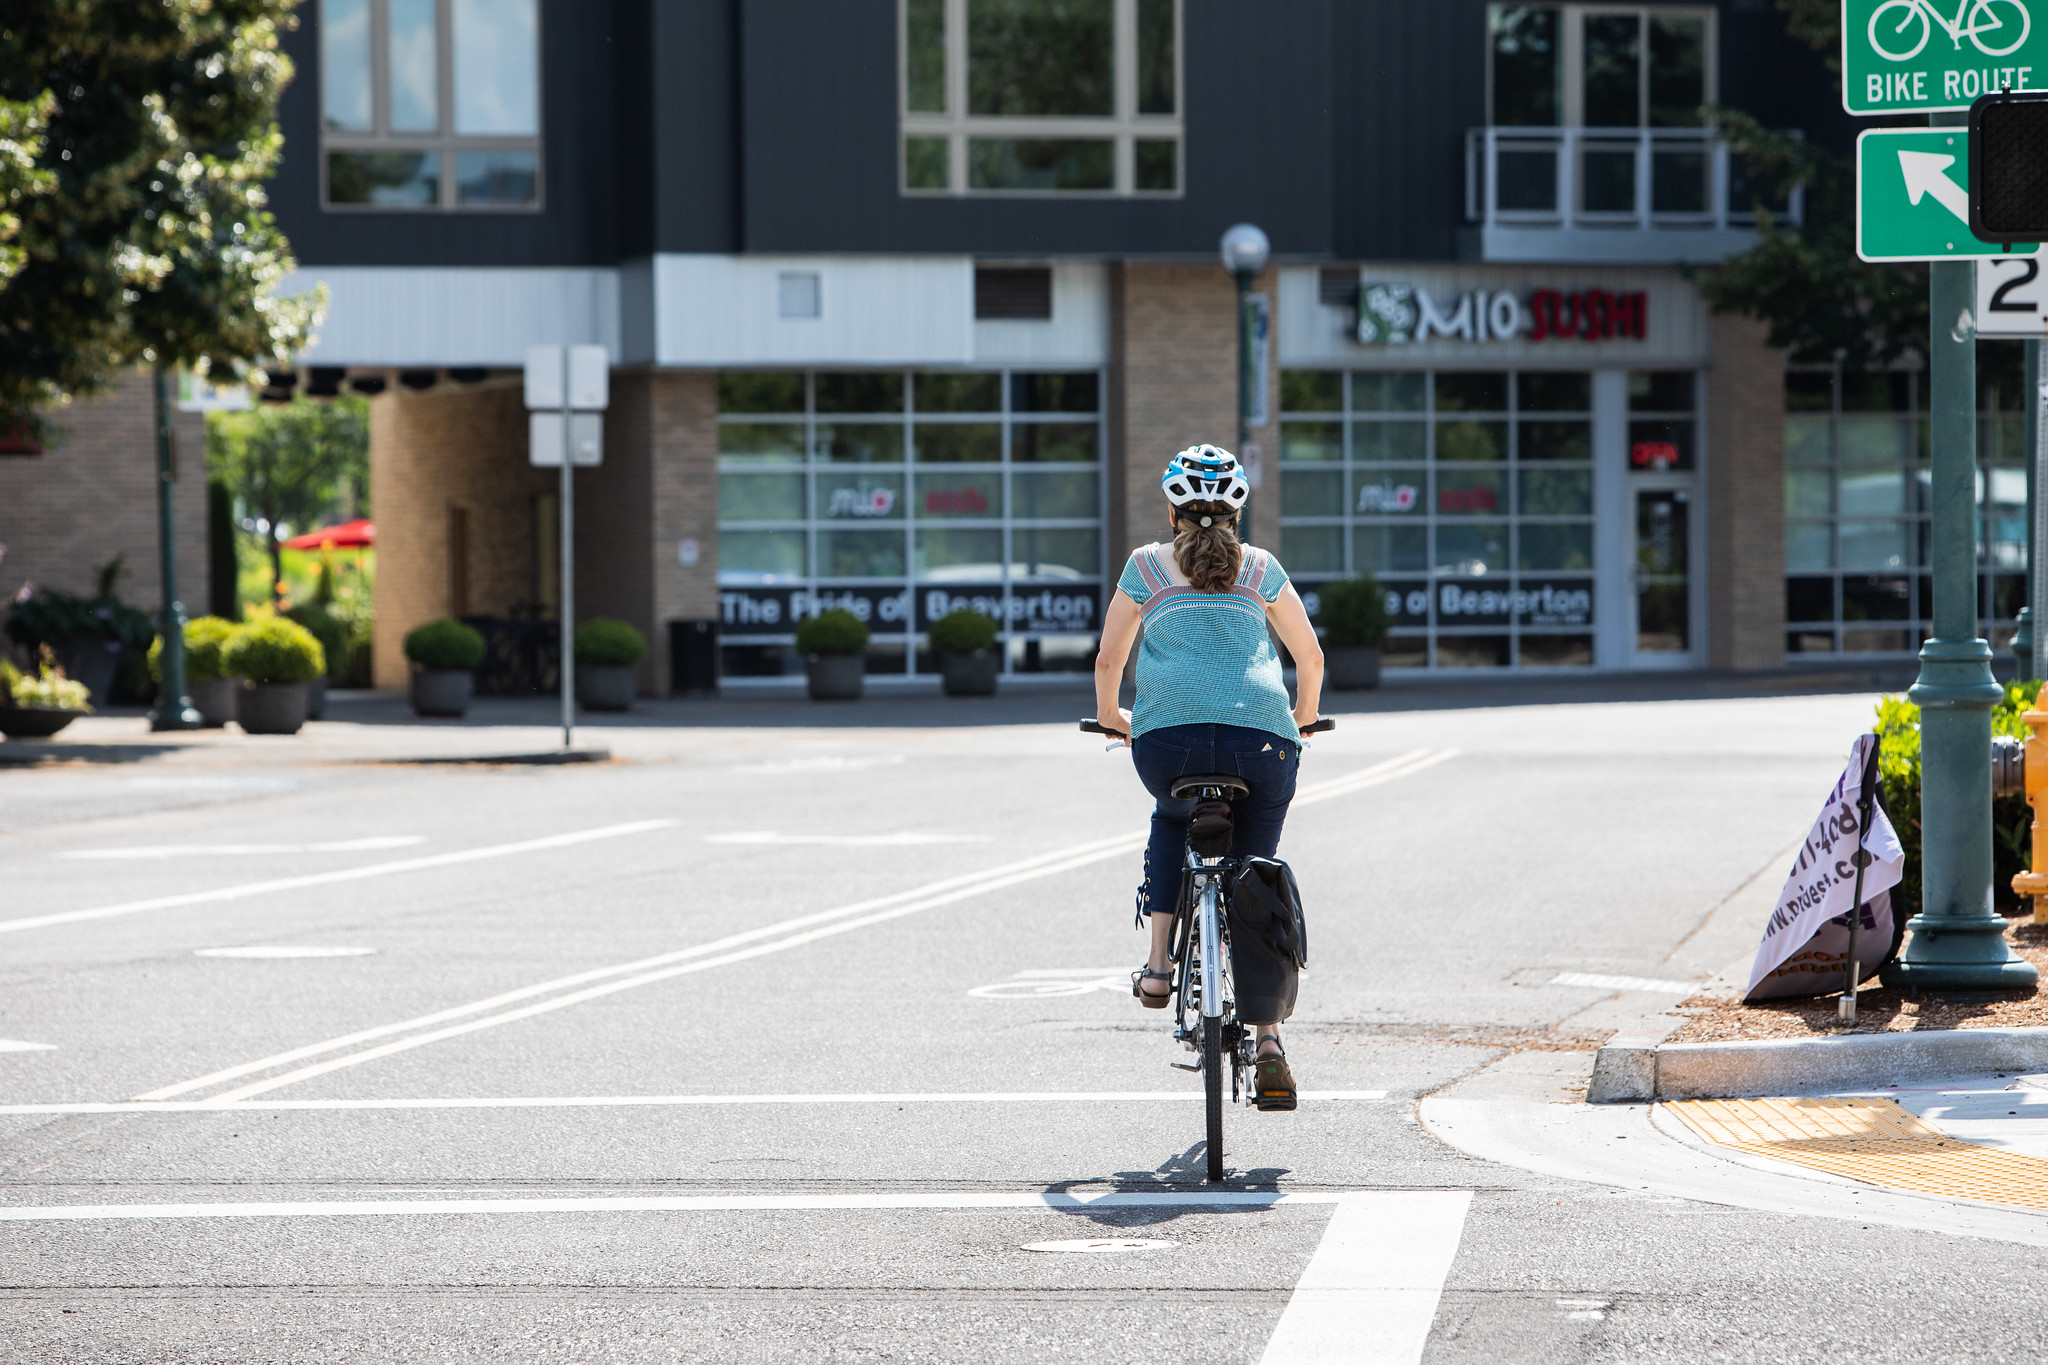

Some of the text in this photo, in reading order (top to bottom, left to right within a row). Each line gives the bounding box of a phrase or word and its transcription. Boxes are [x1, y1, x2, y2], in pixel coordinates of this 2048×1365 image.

[1866, 66, 2033, 103] BIKE ROUTE
[1413, 288, 1647, 342] MIO SUSHI
[720, 592, 780, 624] The
[925, 590, 1094, 624] Beaverton
[1440, 583, 1590, 616] Beaverton
